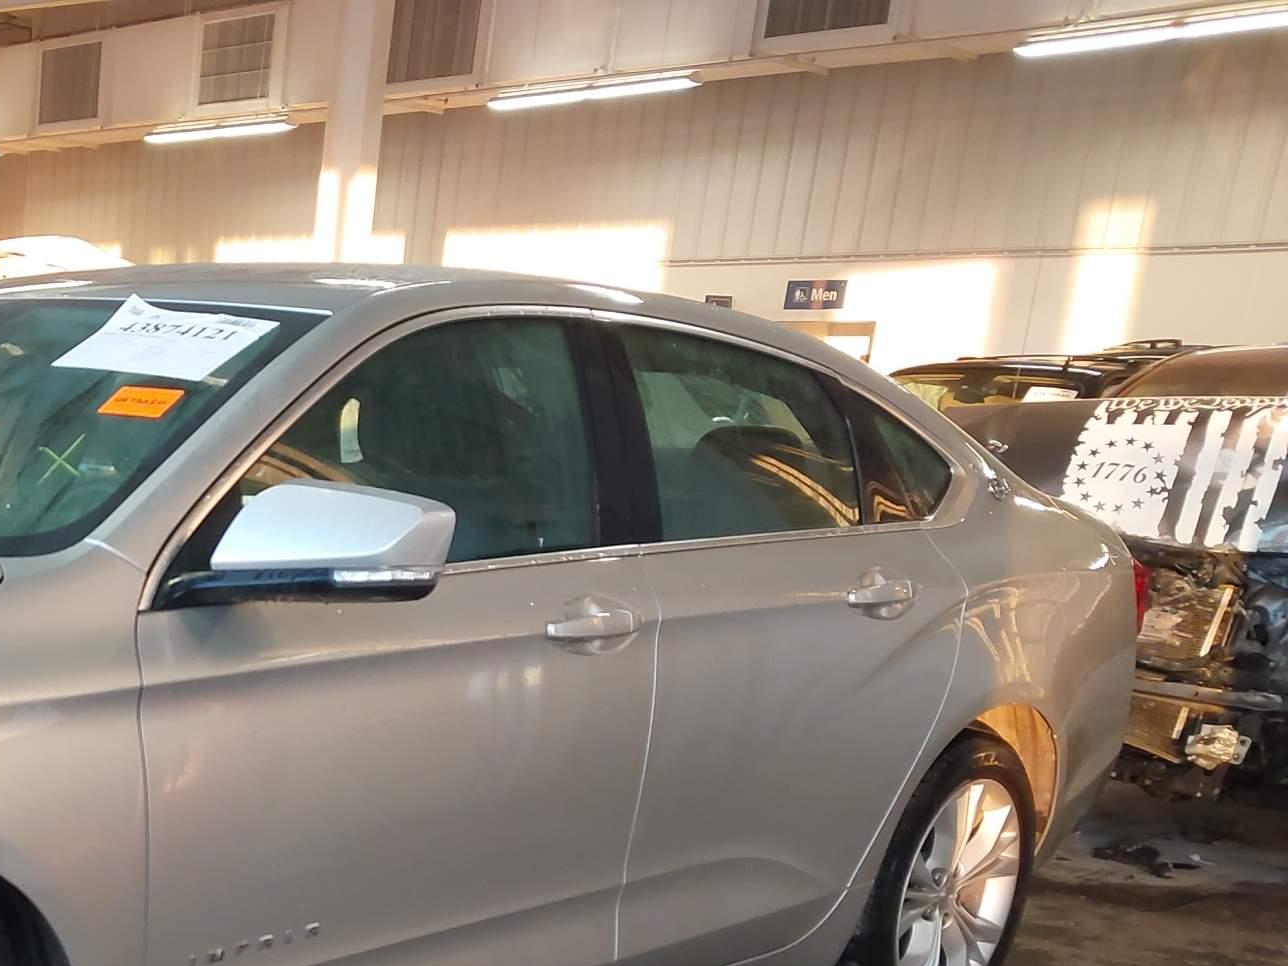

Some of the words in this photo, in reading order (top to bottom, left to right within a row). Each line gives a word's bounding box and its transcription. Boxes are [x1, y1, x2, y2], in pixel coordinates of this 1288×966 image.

[811, 287, 838, 301] Men
[120, 321, 238, 341] 43874121
[1091, 461, 1149, 485] 1776
